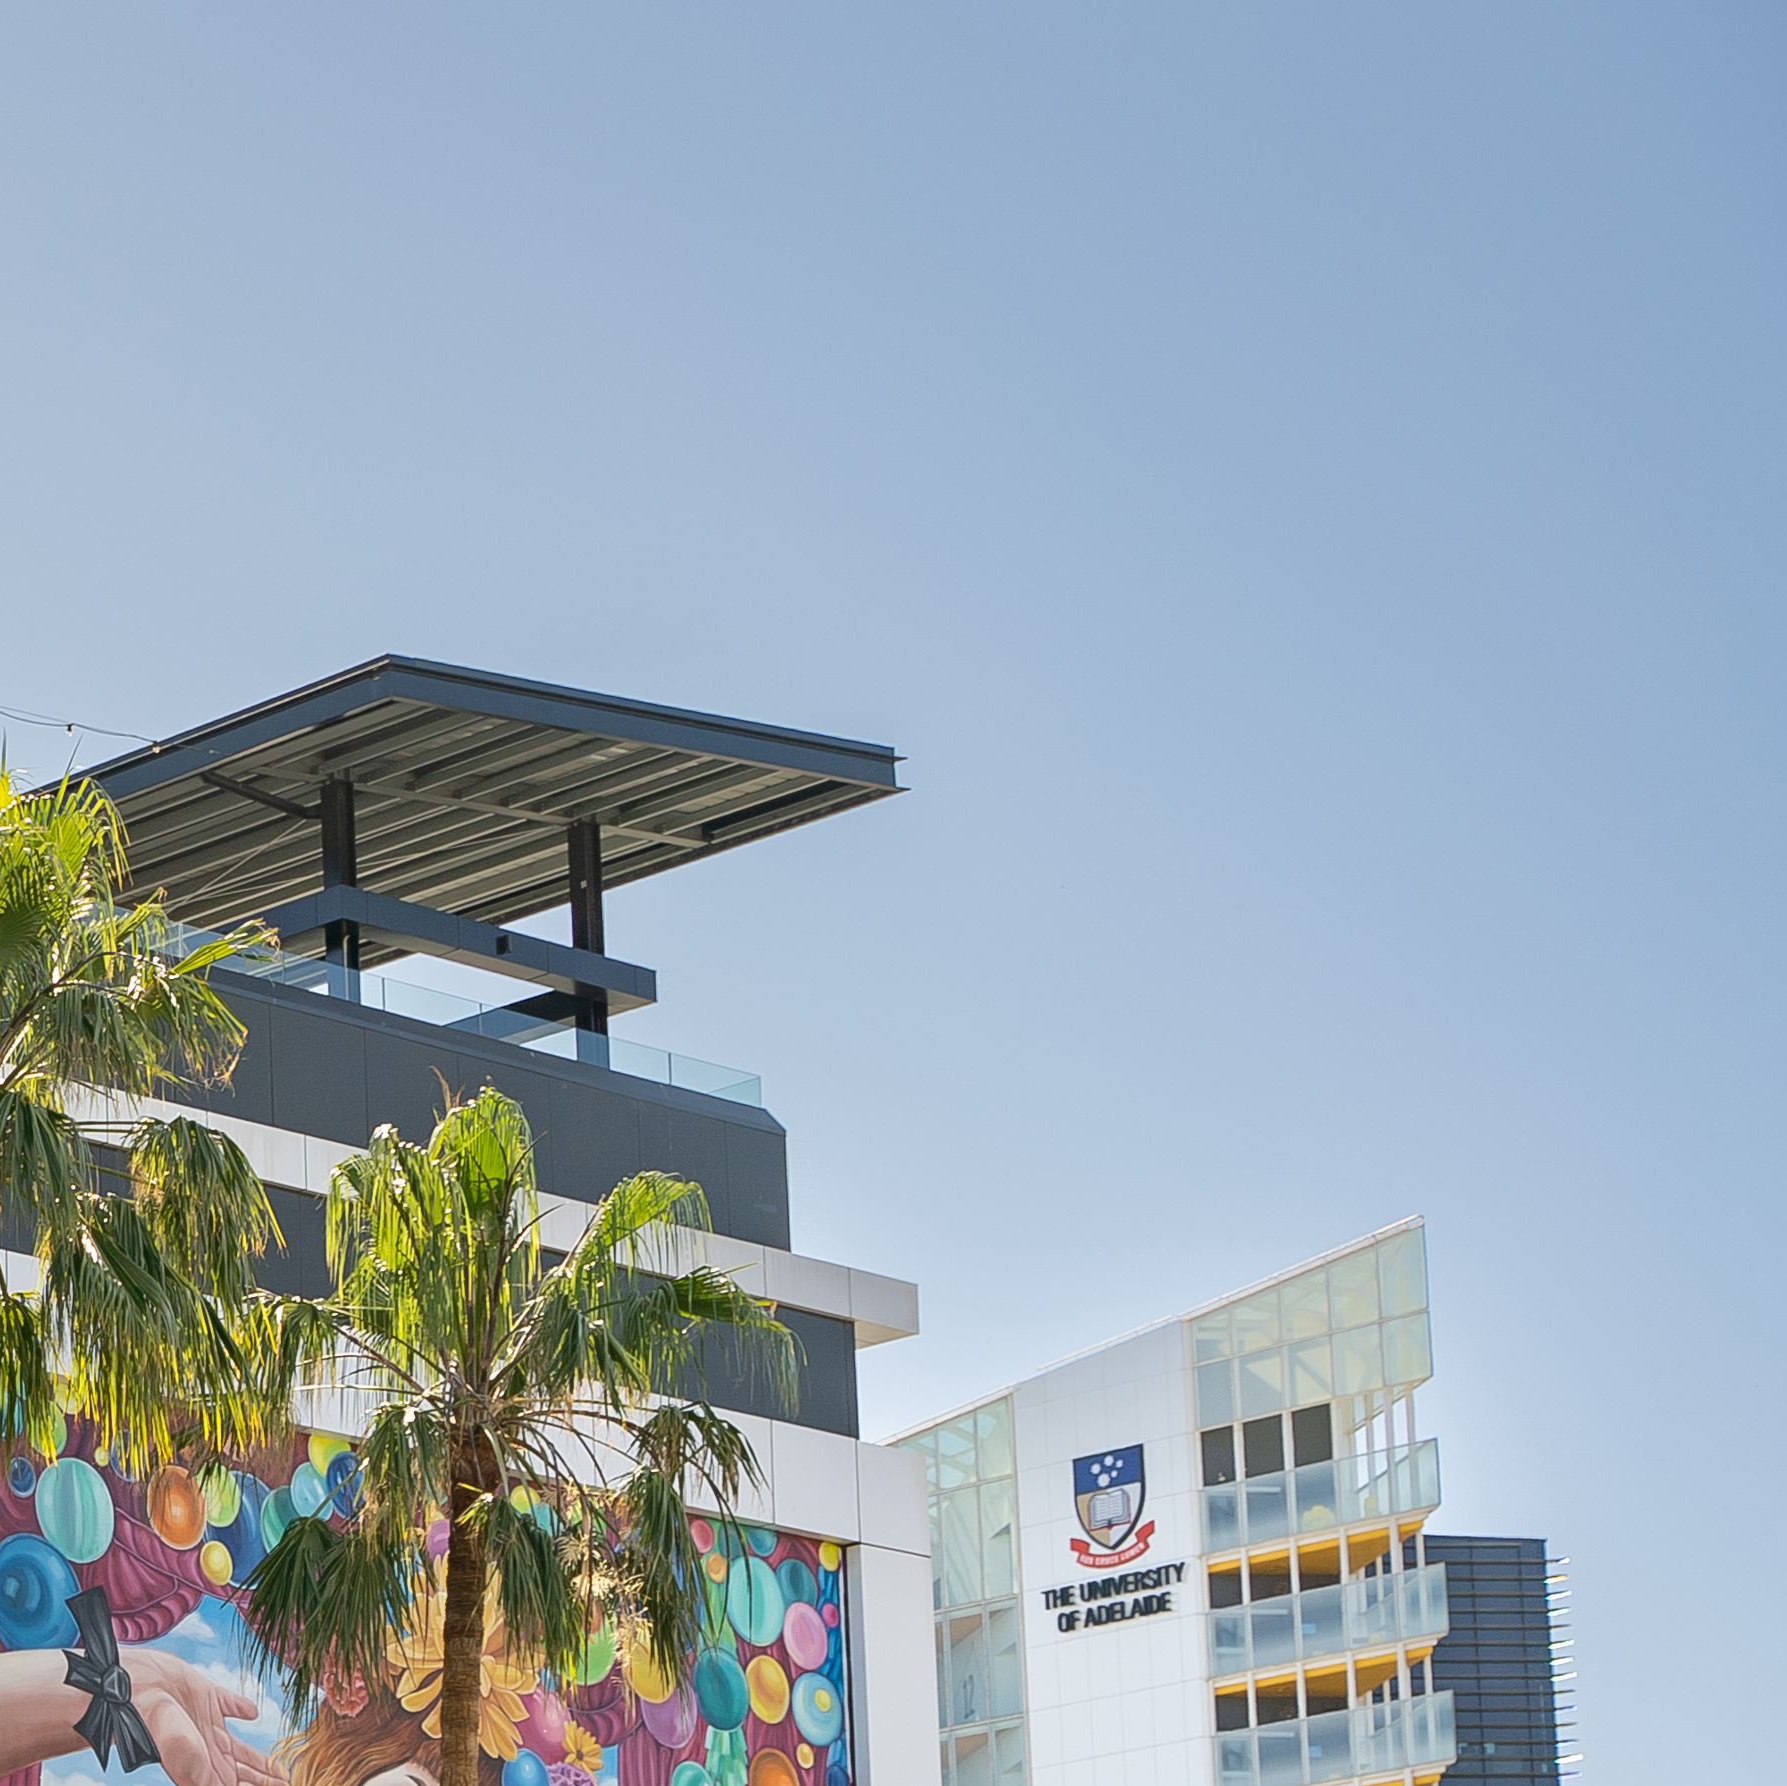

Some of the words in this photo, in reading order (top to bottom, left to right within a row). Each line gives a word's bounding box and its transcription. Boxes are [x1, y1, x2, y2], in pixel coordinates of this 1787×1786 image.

[1041, 1586, 1076, 1610] THE
[1079, 1562, 1186, 1603] UNIVERSITY
[1058, 1610, 1080, 1632] OF
[1084, 1591, 1172, 1628] ADELAIDE
